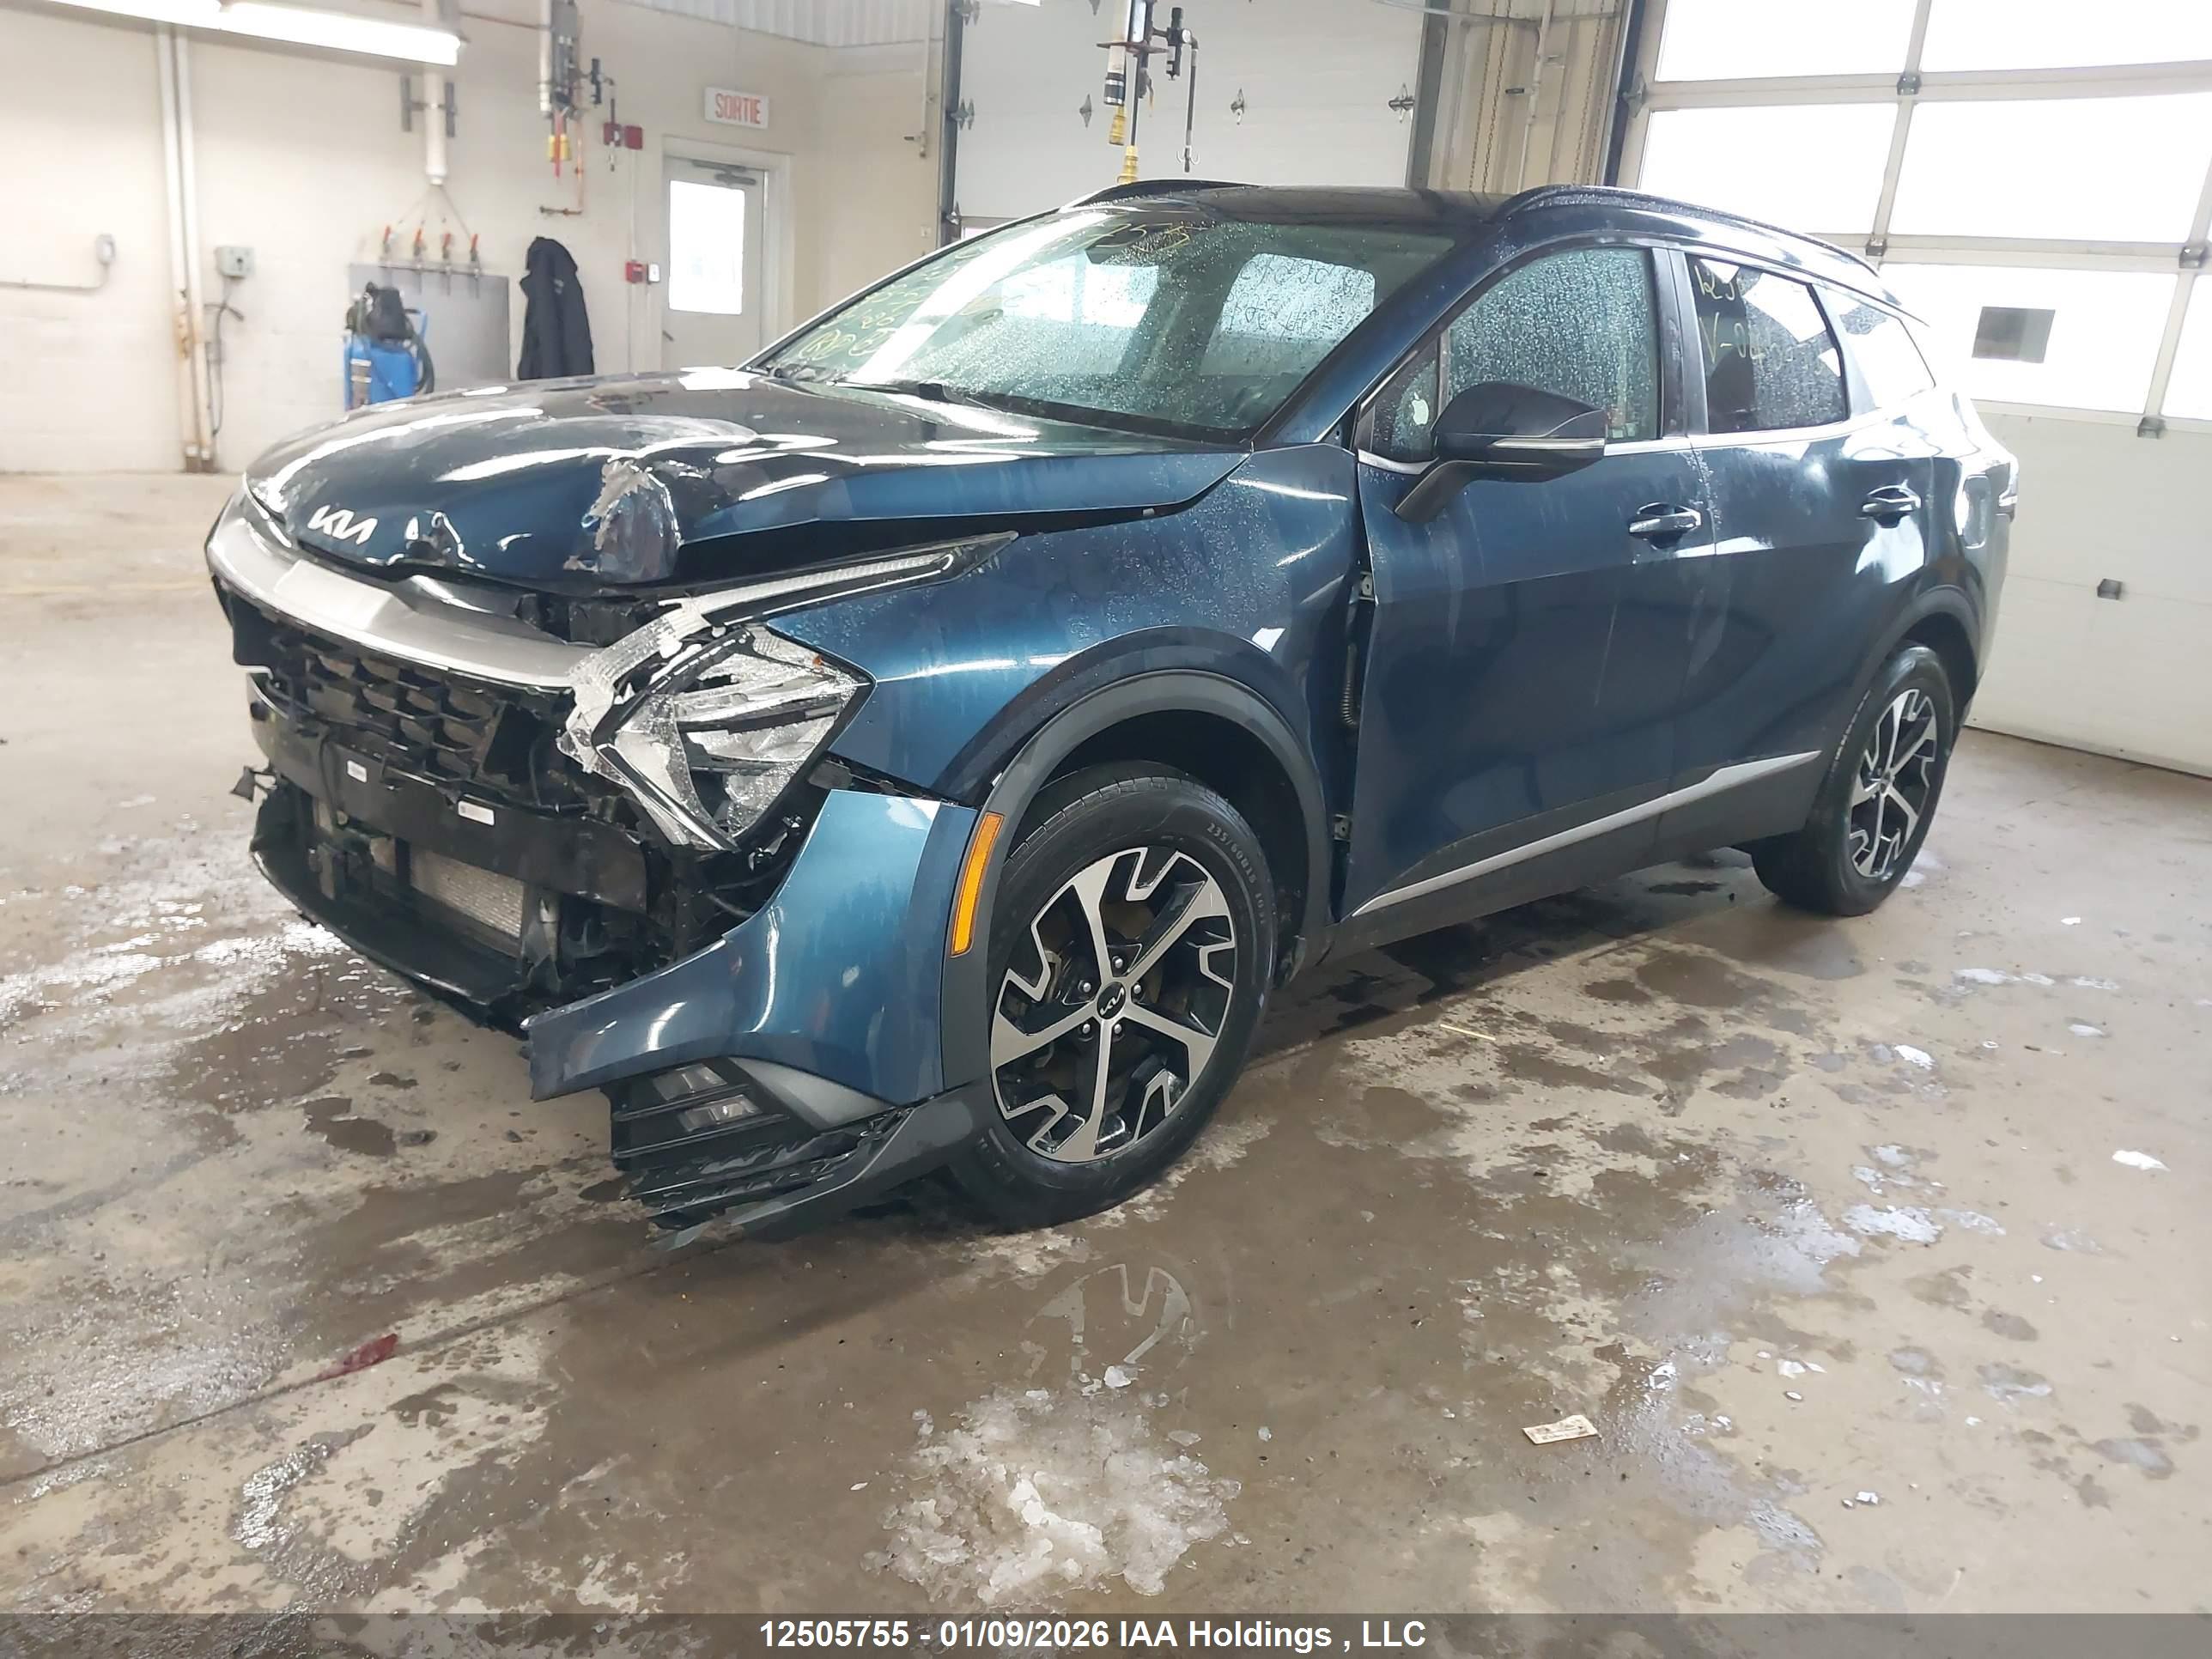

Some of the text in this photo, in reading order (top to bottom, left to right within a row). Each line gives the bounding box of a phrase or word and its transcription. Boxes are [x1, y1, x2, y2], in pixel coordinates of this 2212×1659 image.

[714, 92, 762, 125] SORTIE
[307, 504, 379, 546] KIA
[1099, 987, 1125, 1016] KIA
